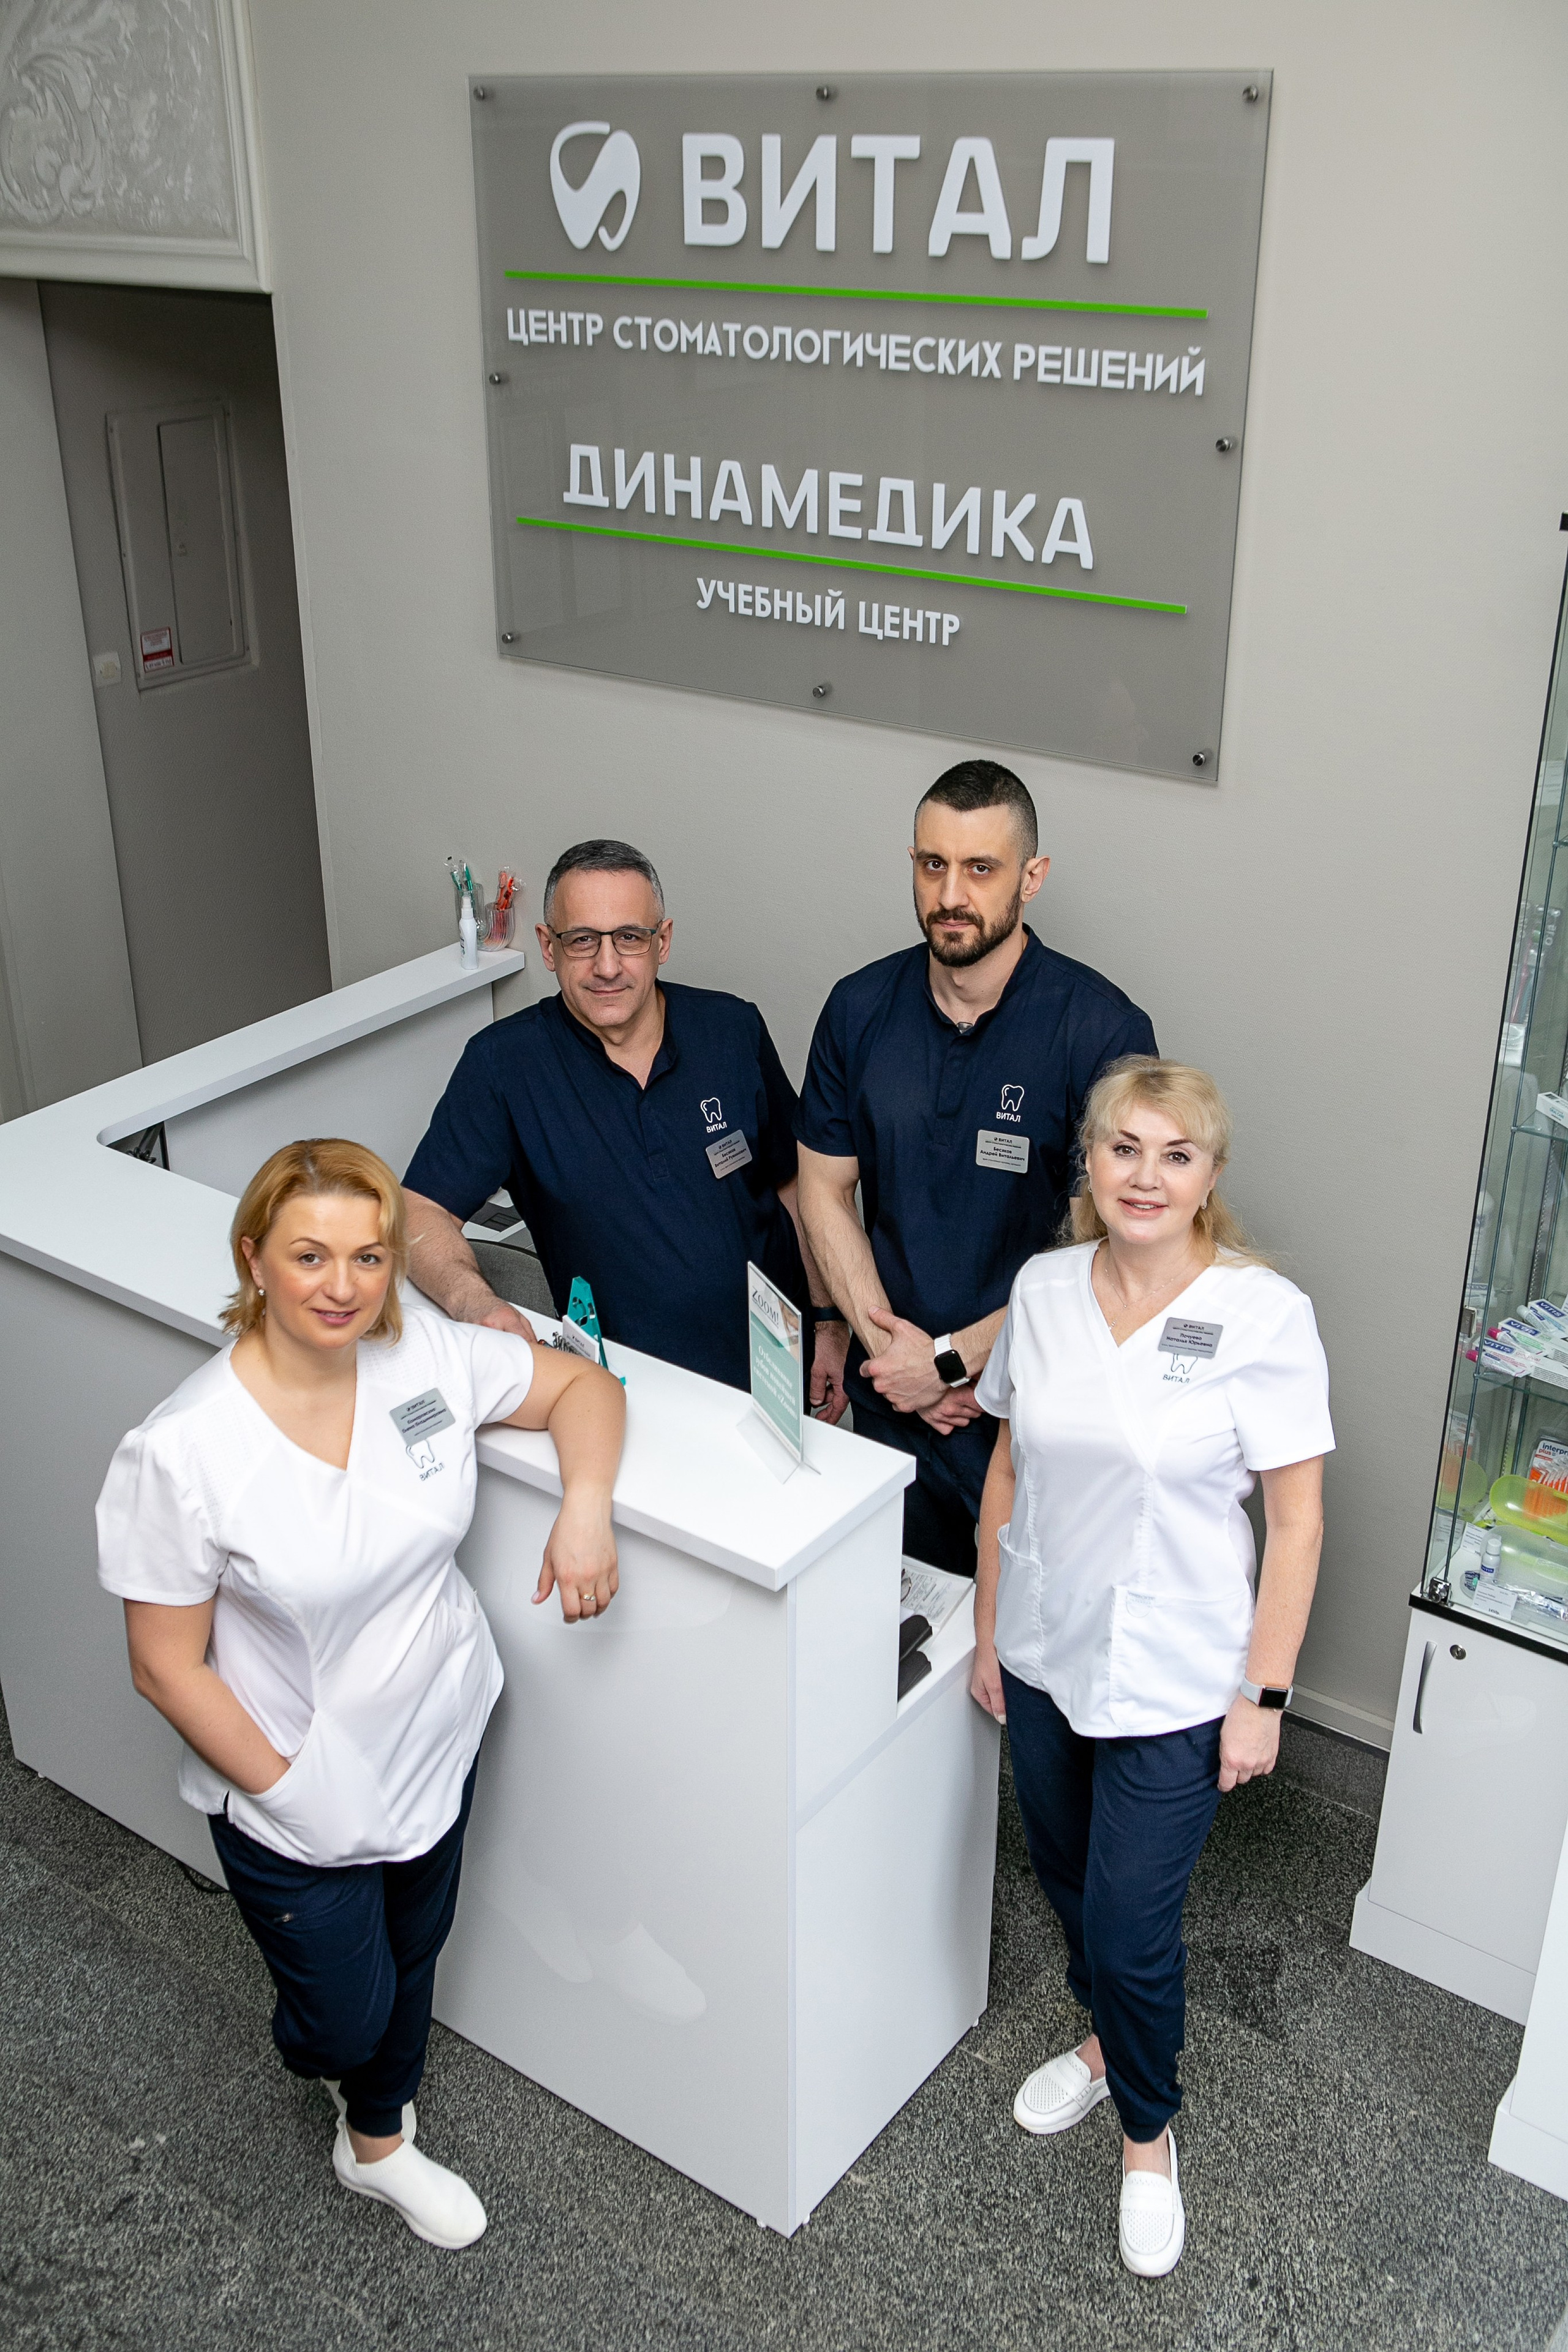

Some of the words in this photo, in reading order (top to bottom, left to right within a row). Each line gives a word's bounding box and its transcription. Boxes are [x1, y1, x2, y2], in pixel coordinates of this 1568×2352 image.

[682, 134, 1115, 263] ВИТАЛ
[507, 308, 603, 345] ЦЕНТР
[612, 316, 1003, 379] СТОМАТОЛОГИЧЕСКИХ
[1014, 344, 1207, 396] РЕШЕНИЙ
[562, 443, 1095, 571] ДИНАМЕДИКА
[696, 577, 846, 630] УЧЕБНЫЙ
[858, 600, 961, 647] ЦЕНТР
[996, 1111, 1021, 1123] ВИТАЛ
[706, 1121, 727, 1133] ВИТАЛ
[752, 1286, 779, 1325] ZOOM!
[1540, 1302, 1562, 1317] VITIS
[1510, 1321, 1536, 1335] VITIS
[1485, 1340, 1512, 1352] VITIS
[1163, 1374, 1190, 1384] ВИТАЛ
[1542, 1442, 1568, 1456] interpr
[419, 1462, 445, 1481] ВИТАЛ
